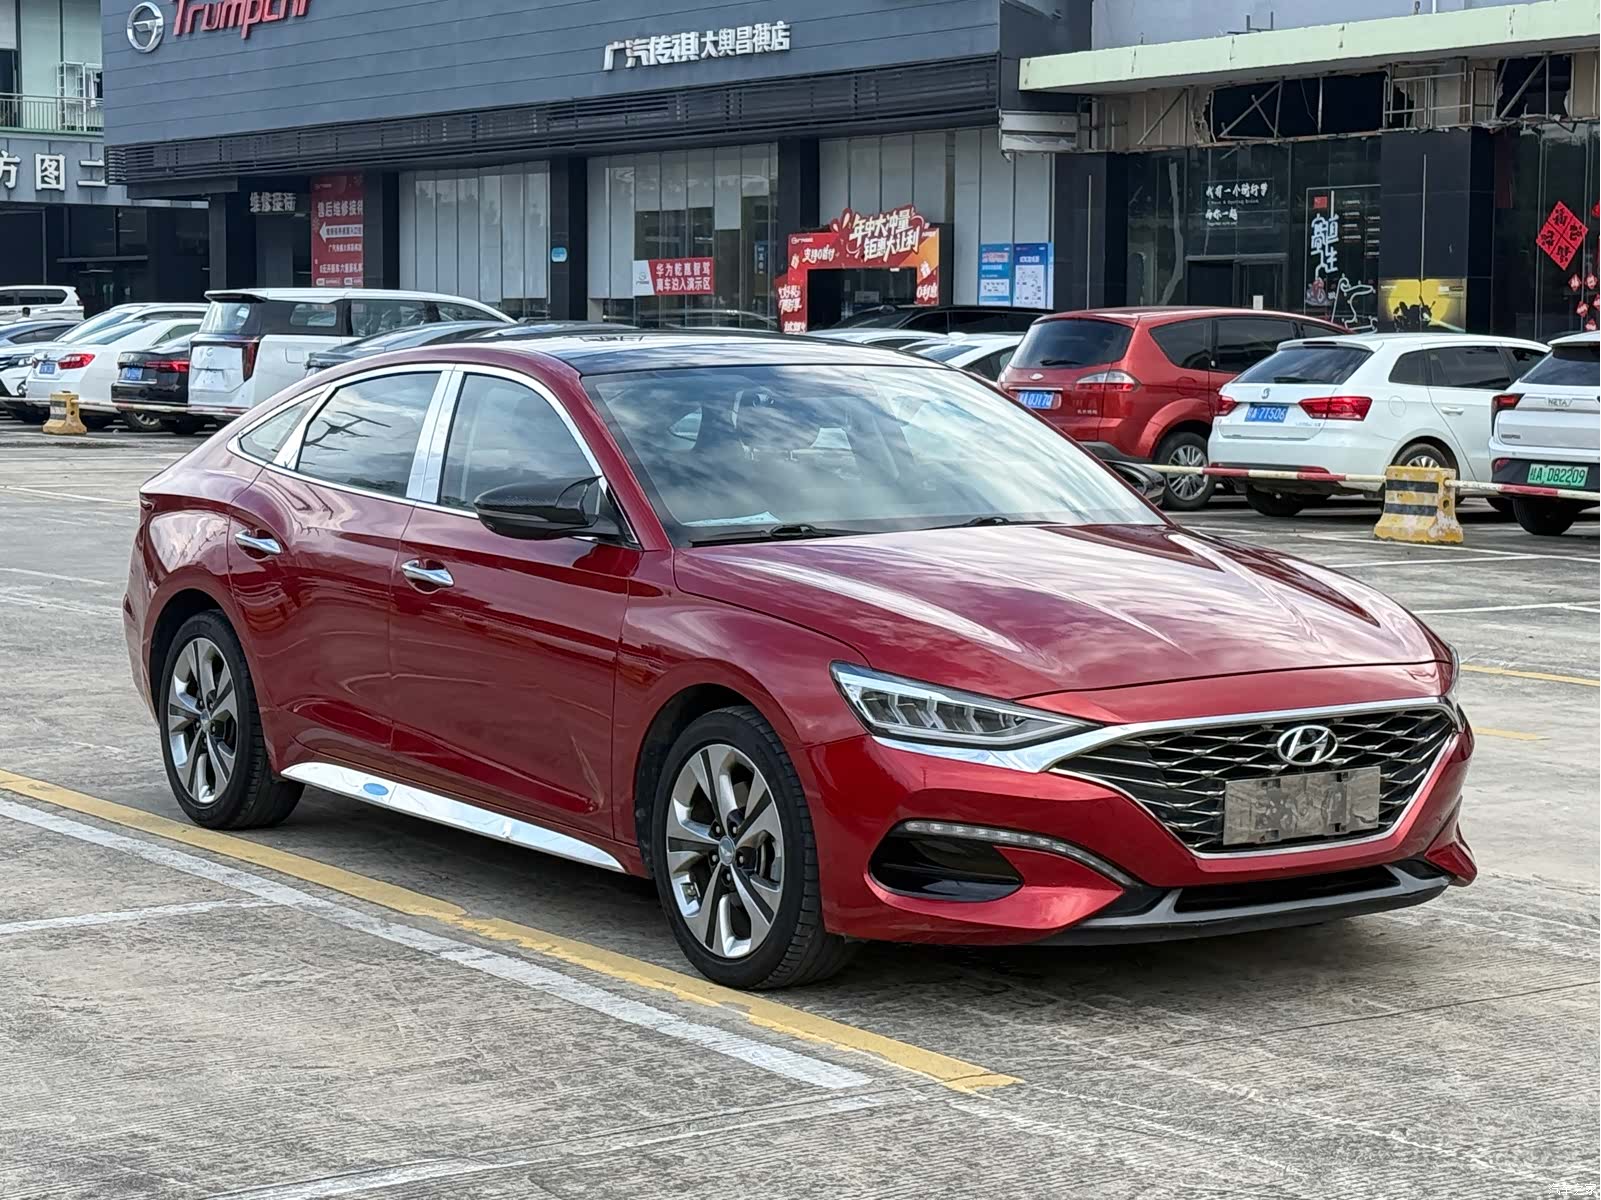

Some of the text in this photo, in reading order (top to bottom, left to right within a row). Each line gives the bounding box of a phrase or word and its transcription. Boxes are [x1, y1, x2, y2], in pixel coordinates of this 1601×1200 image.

[849, 208, 914, 248] 年中大冲量
